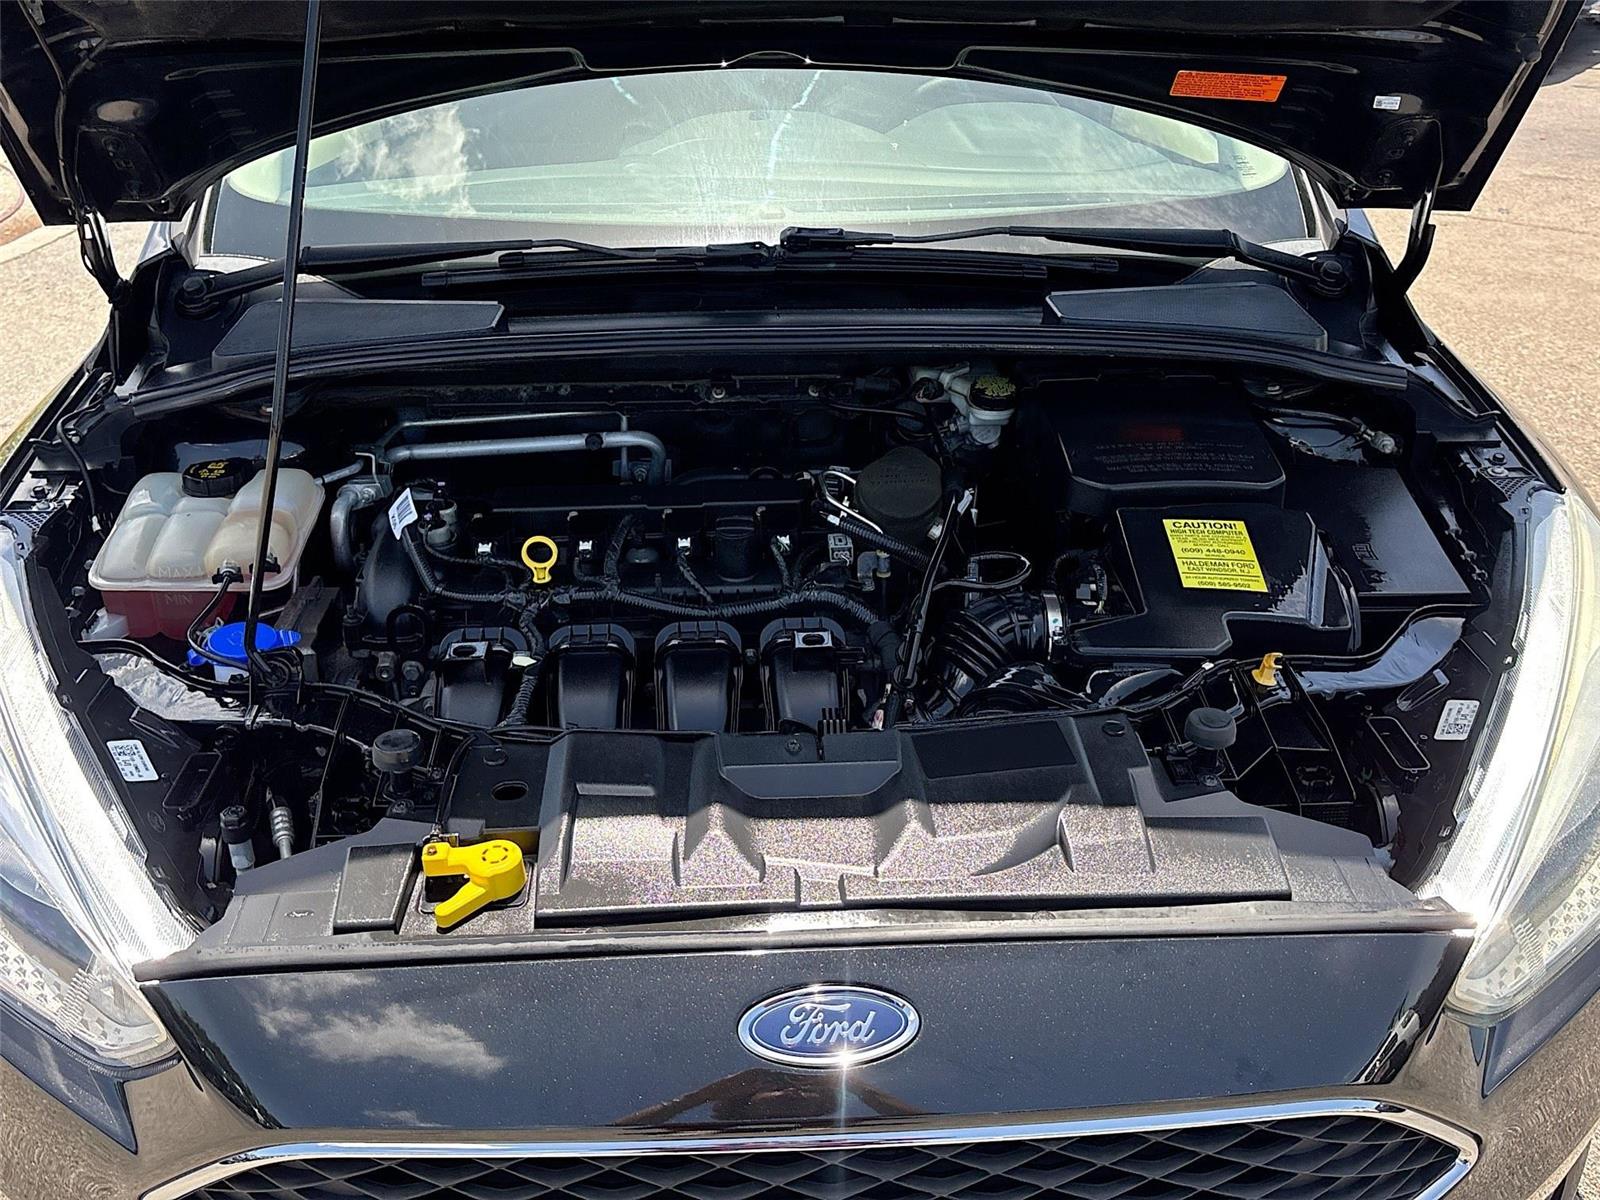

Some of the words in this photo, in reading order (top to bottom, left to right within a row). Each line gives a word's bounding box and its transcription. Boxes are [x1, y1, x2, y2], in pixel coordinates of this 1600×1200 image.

[1172, 521, 1238, 530] CAUTION!
[1181, 560, 1230, 568] HALDEMAN
[780, 1002, 876, 1046] Ford
